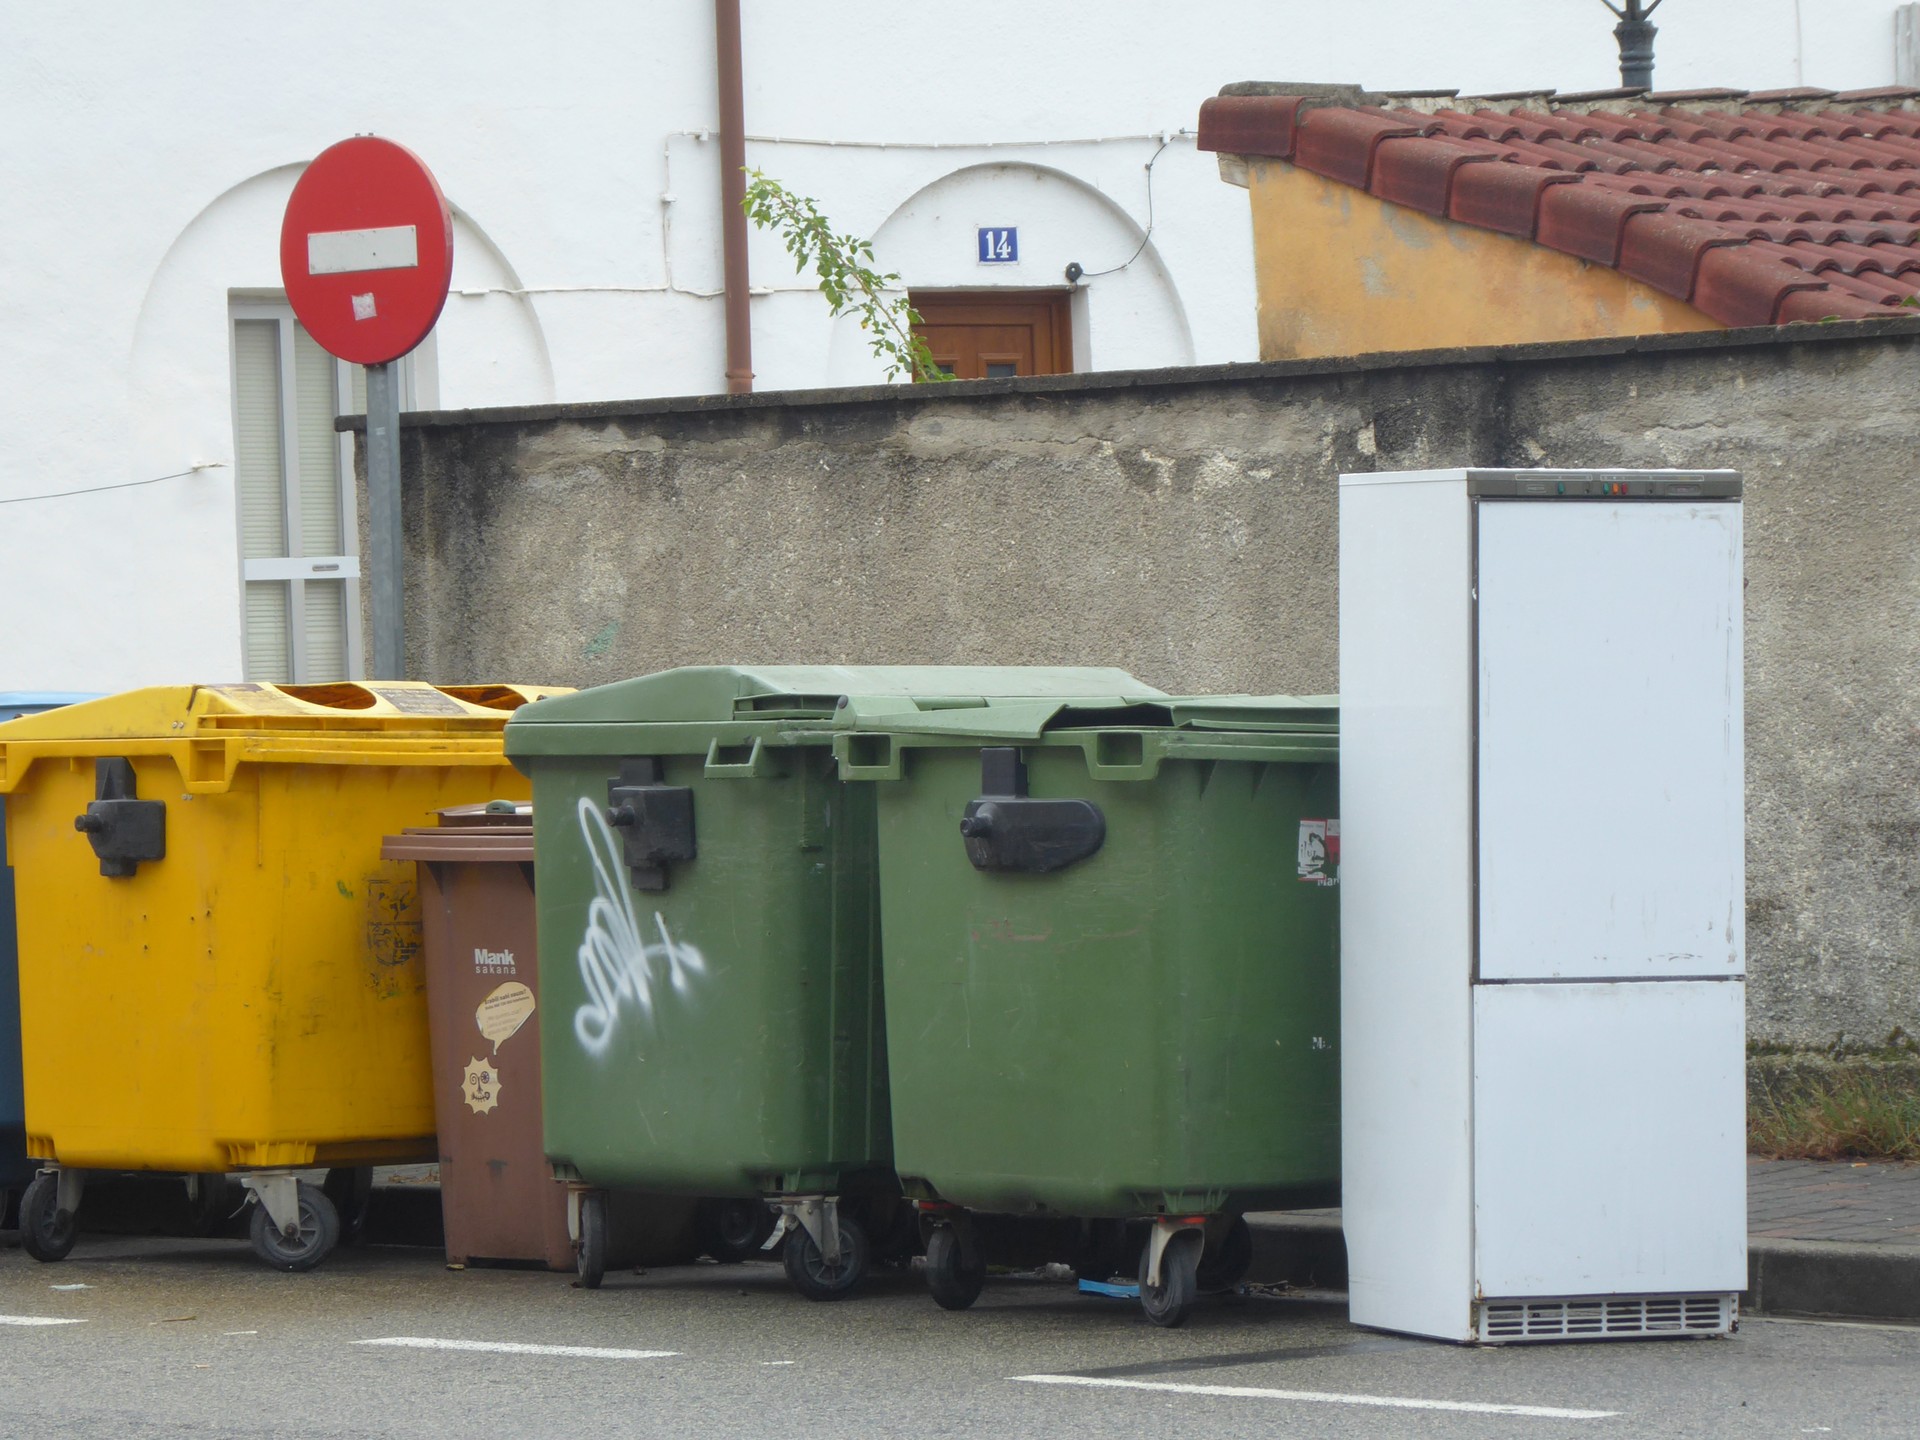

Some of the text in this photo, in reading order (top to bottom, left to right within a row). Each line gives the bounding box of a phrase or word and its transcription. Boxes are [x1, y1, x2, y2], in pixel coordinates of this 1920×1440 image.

[985, 230, 1012, 259] 14
[474, 948, 515, 965] Mank
[475, 964, 516, 974] sakana
